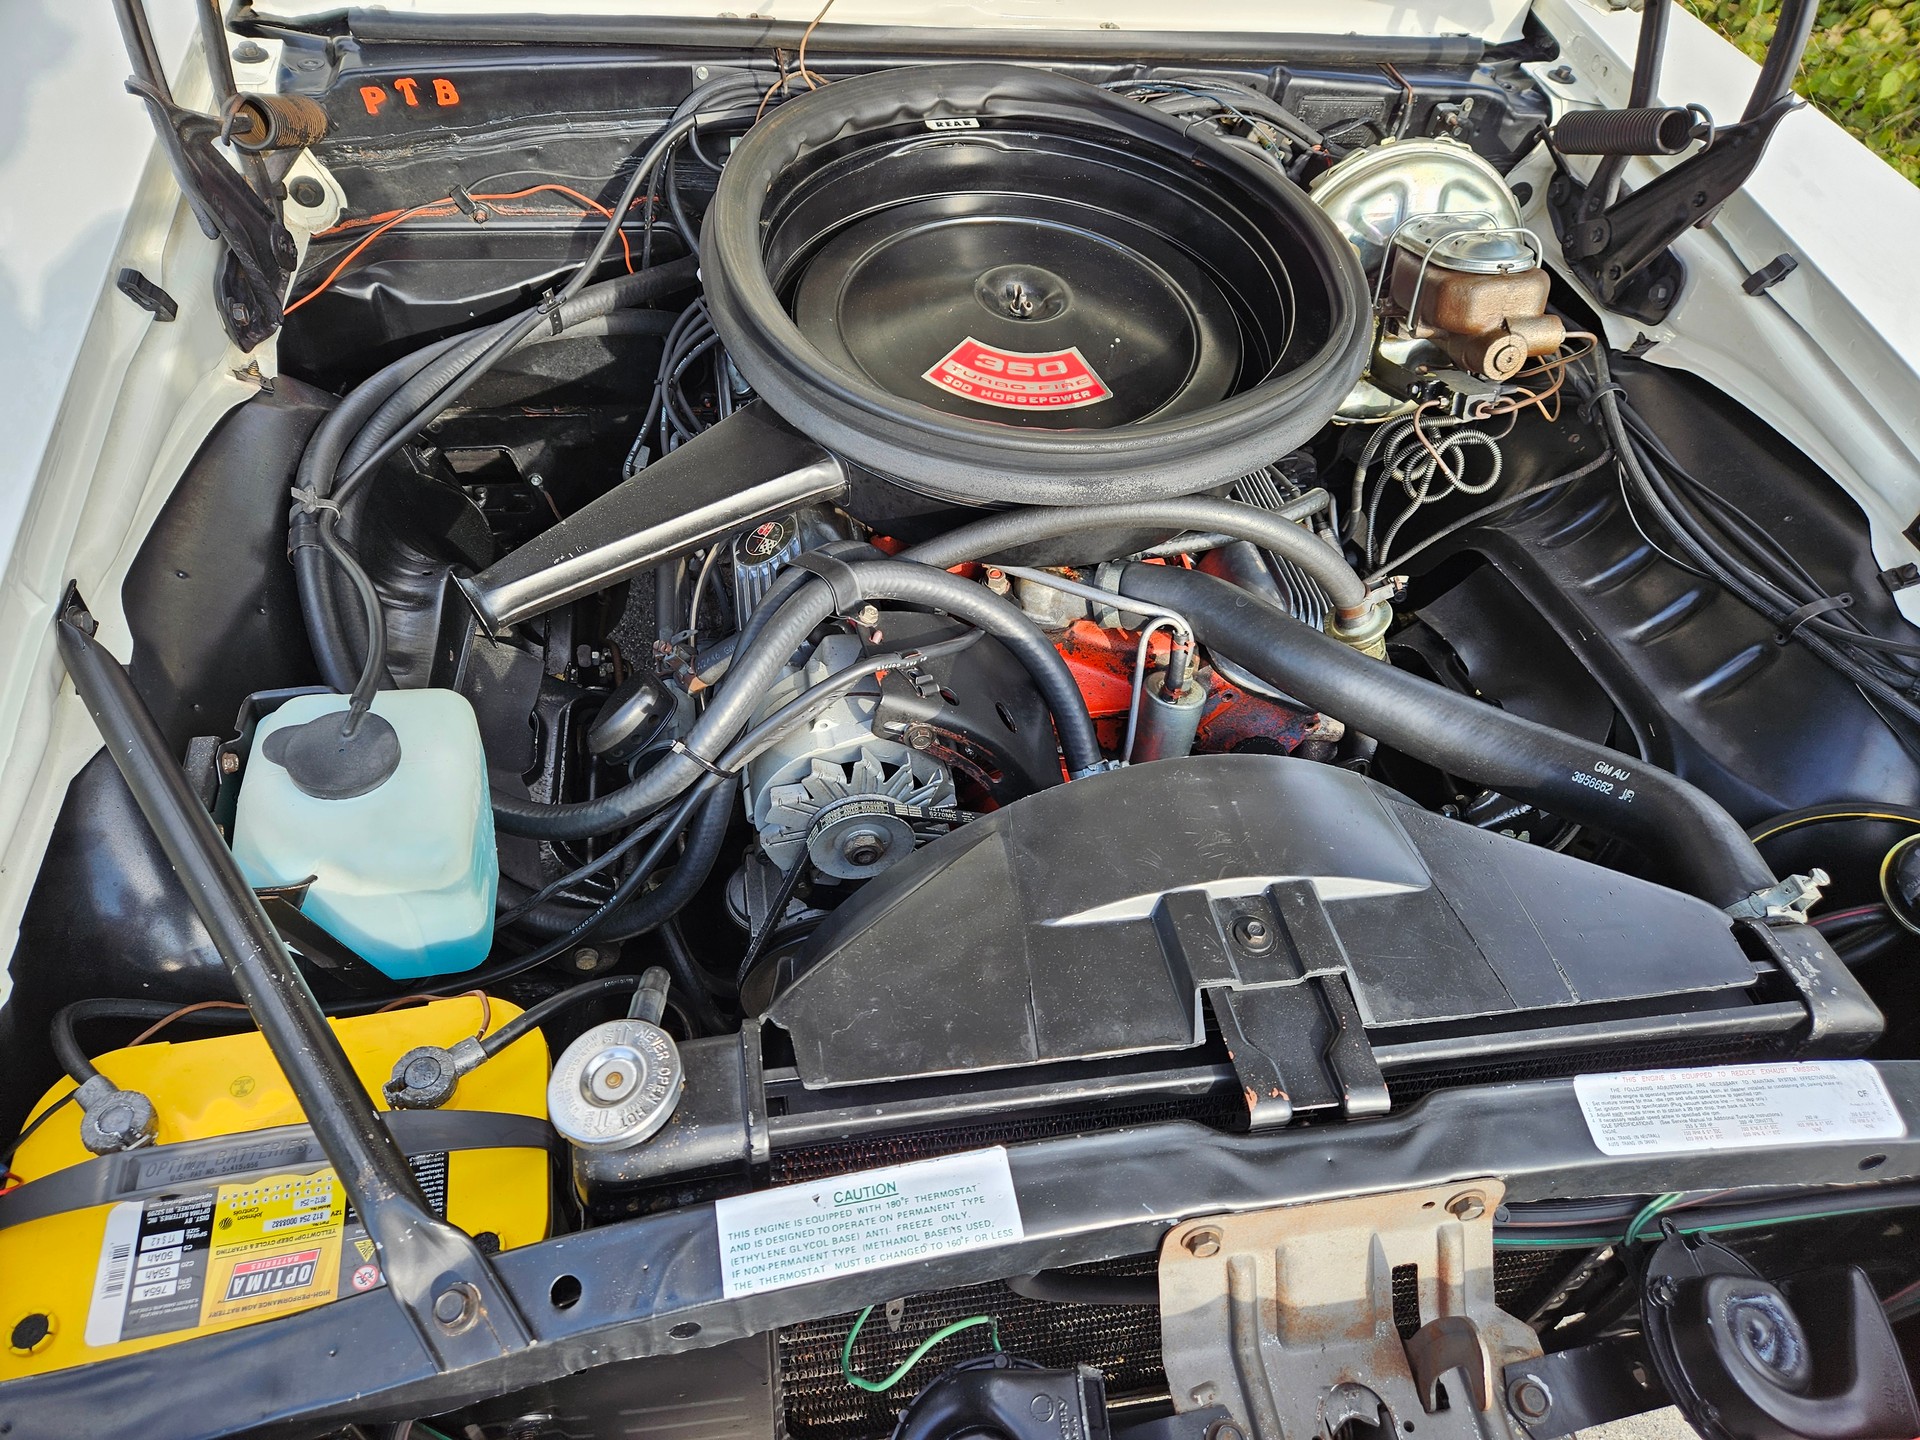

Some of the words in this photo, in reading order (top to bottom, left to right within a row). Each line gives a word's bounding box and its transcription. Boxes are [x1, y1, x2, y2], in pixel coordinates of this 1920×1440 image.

[974, 353, 1068, 377] 350
[951, 363, 1090, 391] TURBO-FIRE
[942, 374, 972, 393] 300
[980, 389, 1091, 404] HORSEPOWER
[1594, 760, 1614, 776] GM
[1611, 768, 1631, 781] AU
[1571, 771, 1614, 795] 3956662
[635, 1028, 670, 1061] NEVER
[648, 1066, 671, 1105] OPEN
[618, 1104, 647, 1129] HOT
[145, 1152, 207, 1178] OPTIMA
[833, 1181, 897, 1204] CAUTION
[233, 1206, 259, 1216] Controls
[237, 1211, 263, 1221] Johnson
[729, 1229, 750, 1241] THIS
[759, 1222, 790, 1235] ENGINE
[795, 1219, 802, 1228] IS
[806, 1210, 852, 1225] EQUIPPED
[858, 1204, 882, 1215] WITH
[886, 1196, 909, 1209] 180°F
[915, 1185, 978, 1204] THERMOSTAT
[730, 1242, 750, 1253] AND
[755, 1240, 762, 1248] IS
[766, 1229, 815, 1246] DESIGNED
[818, 1226, 830, 1236] TO
[832, 1217, 876, 1233] OPERATE
[880, 1214, 893, 1223] ON
[898, 1202, 955, 1220] PERMANENT
[962, 1196, 985, 1207] TYPE
[216, 1245, 248, 1255] STARTING
[255, 1240, 275, 1248] CYCLE
[277, 1236, 293, 1244] DEEP
[731, 1247, 786, 1266] (ETHYLENE
[790, 1239, 829, 1254] GLYCOL
[833, 1233, 860, 1246] BASE)
[897, 1218, 933, 1233] FREEZE
[941, 1211, 970, 1224] ONLY.
[147, 1251, 173, 1263] 50Ah
[251, 1255, 299, 1270] BATTERIES
[732, 1270, 740, 1279] IF
[744, 1252, 829, 1277] NON-PERMANENT
[833, 1246, 856, 1258] TYPE
[863, 1233, 919, 1252] (METHANOL
[924, 1226, 954, 1239] BASE)
[955, 1225, 962, 1233] IS
[734, 1280, 753, 1292] THE
[760, 1265, 826, 1287] THERMOSTAT
[835, 1258, 861, 1271] MUST
[865, 1255, 876, 1265] BE
[880, 1245, 927, 1262] CHANGED
[931, 1241, 942, 1251] TO
[975, 1232, 987, 1242] OR
[991, 1227, 1013, 1238] LESS
[145, 1267, 171, 1280] 55Ah
[232, 1264, 312, 1295] OPTIMA
[142, 1285, 167, 1298] 765A
[259, 1289, 330, 1308] HIGH-PERFORMANCE
[208, 1306, 240, 1318] BATTERY
[241, 1303, 257, 1311] AGM
